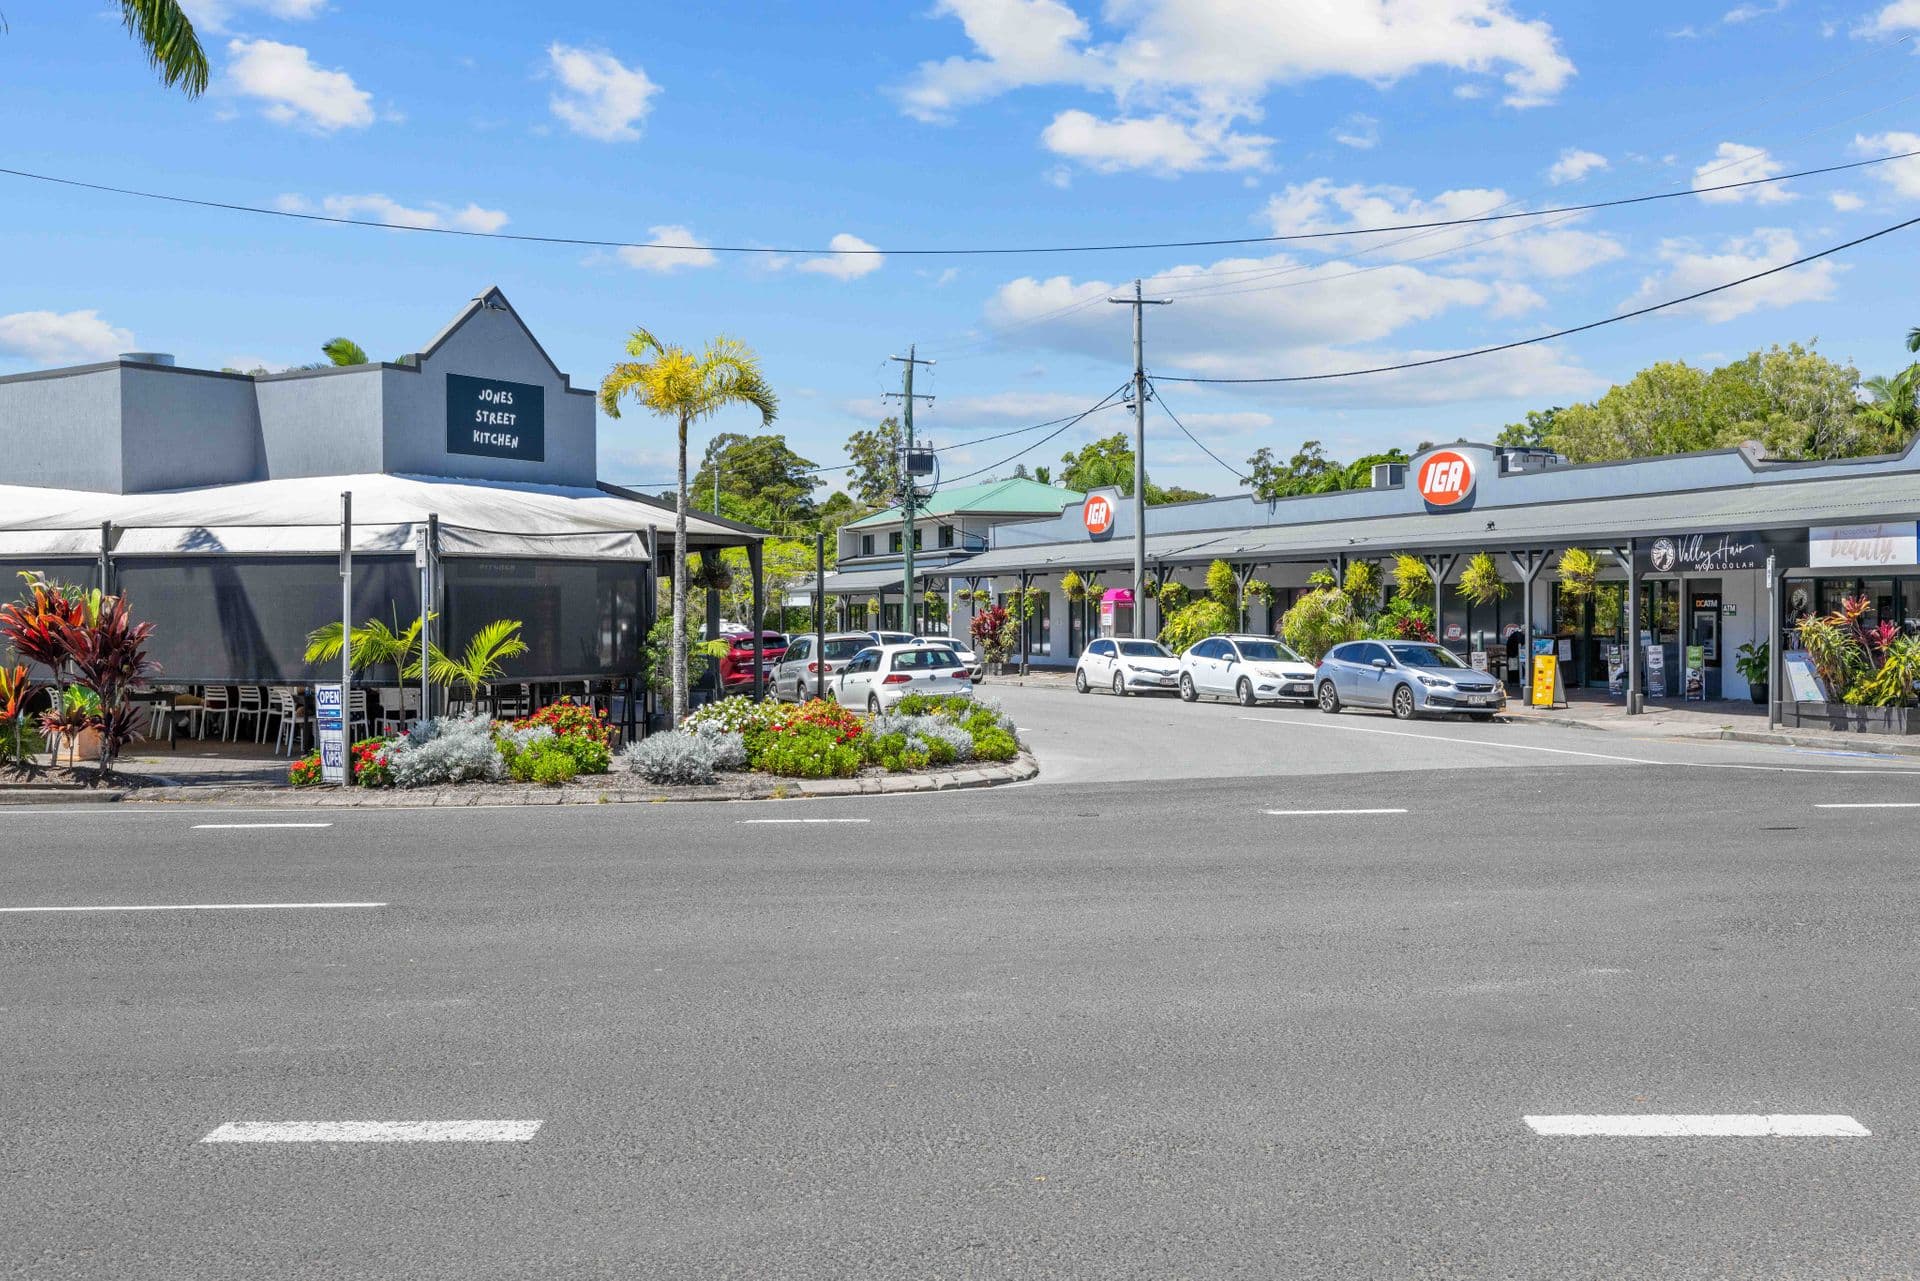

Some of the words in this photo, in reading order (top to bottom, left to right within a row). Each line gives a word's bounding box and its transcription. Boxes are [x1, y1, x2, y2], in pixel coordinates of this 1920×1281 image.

[479, 389, 513, 405] JONES
[476, 409, 517, 426] STREET
[473, 430, 519, 449] KITCHEN
[1423, 460, 1465, 494] IGA
[1086, 502, 1107, 526] IGA
[1678, 534, 1711, 572] Valley
[1711, 535, 1755, 563] Hair
[1694, 561, 1755, 571] MOOLOOLAH
[1723, 604, 1736, 612] ATM
[319, 691, 340, 704] OPEN
[326, 751, 343, 768] OPEN
